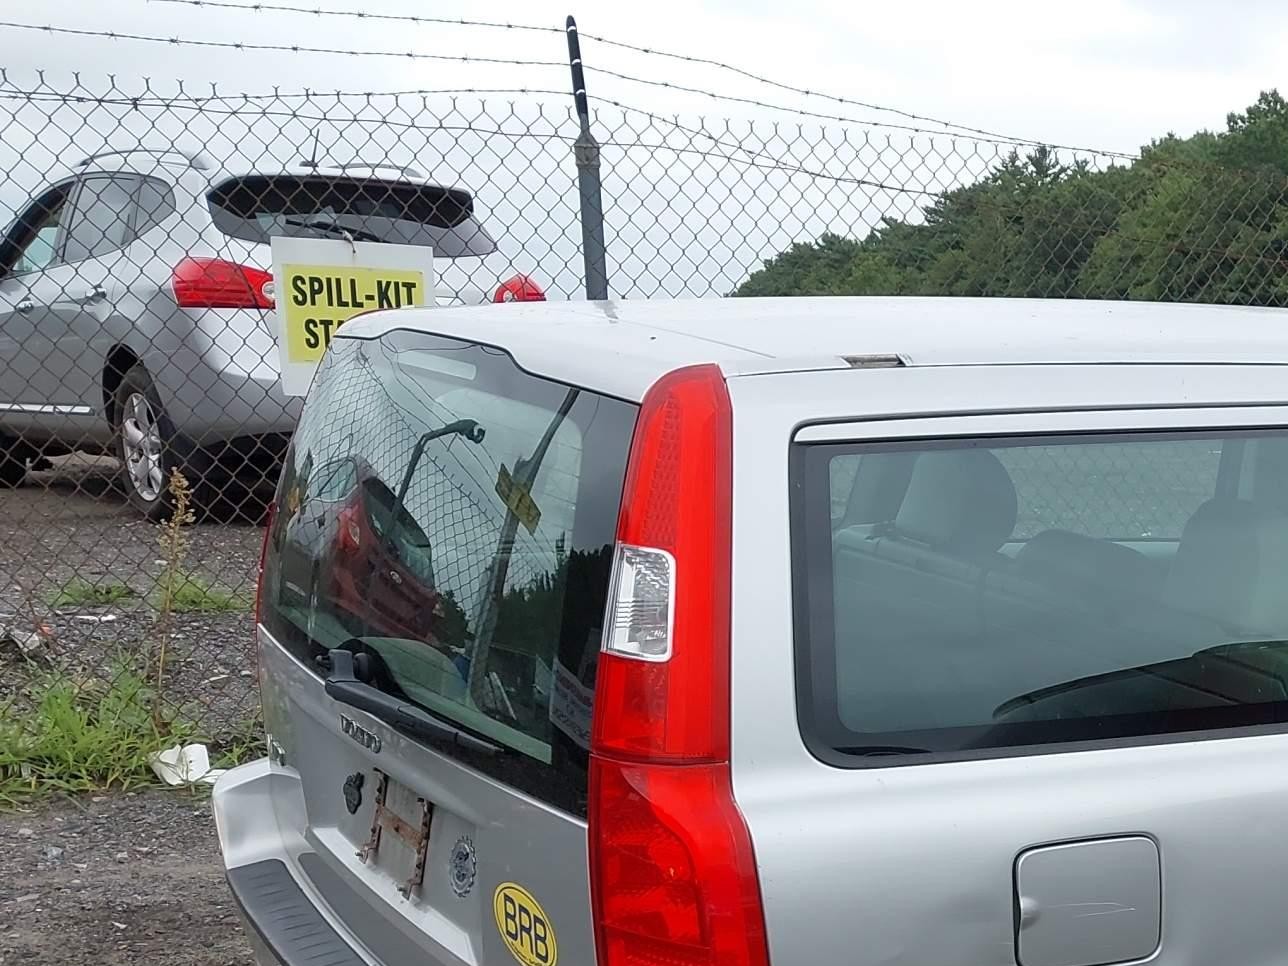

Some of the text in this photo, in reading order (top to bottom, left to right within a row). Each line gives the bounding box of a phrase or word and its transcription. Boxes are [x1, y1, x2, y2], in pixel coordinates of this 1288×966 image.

[292, 275, 416, 309] SPILL-KIT
[304, 318, 346, 349] ST
[503, 892, 549, 964] BRB
